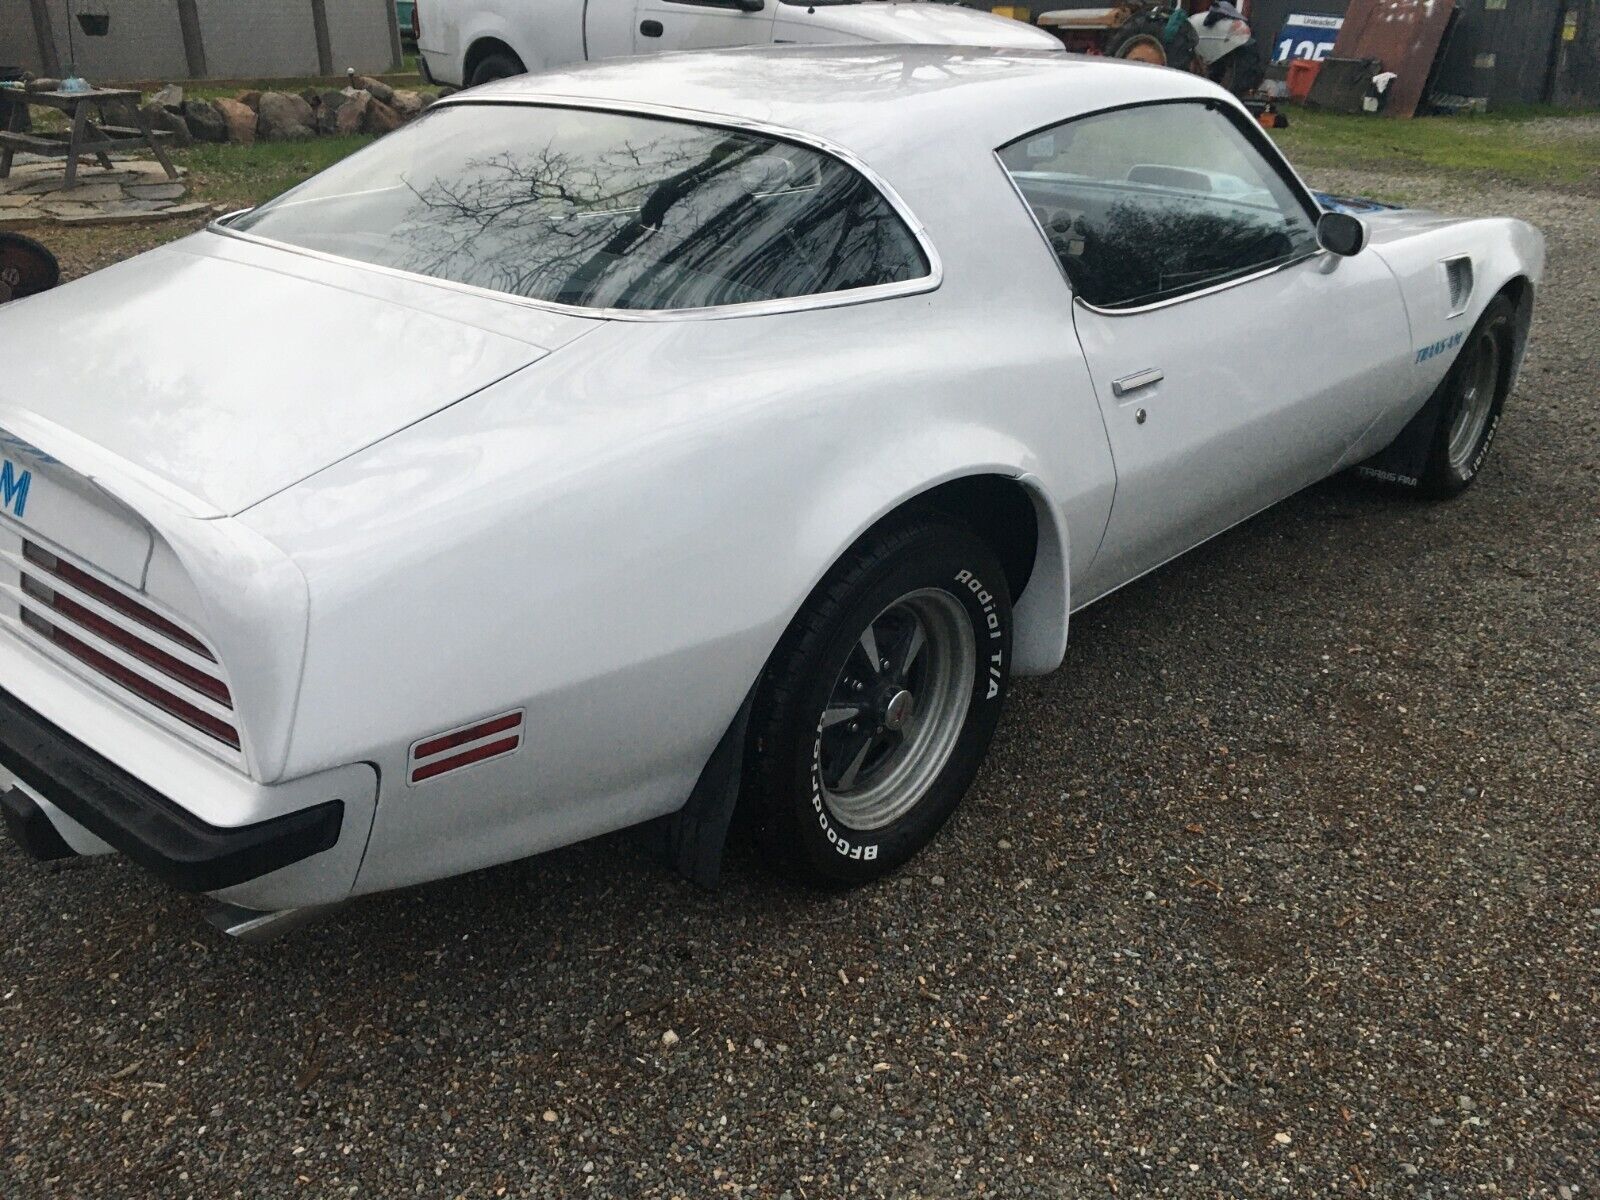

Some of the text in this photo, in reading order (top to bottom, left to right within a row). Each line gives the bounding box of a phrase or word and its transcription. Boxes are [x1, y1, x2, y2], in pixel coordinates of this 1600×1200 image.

[1303, 17, 1337, 27] Unleaded
[953, 568, 1002, 700] Radial T/A
